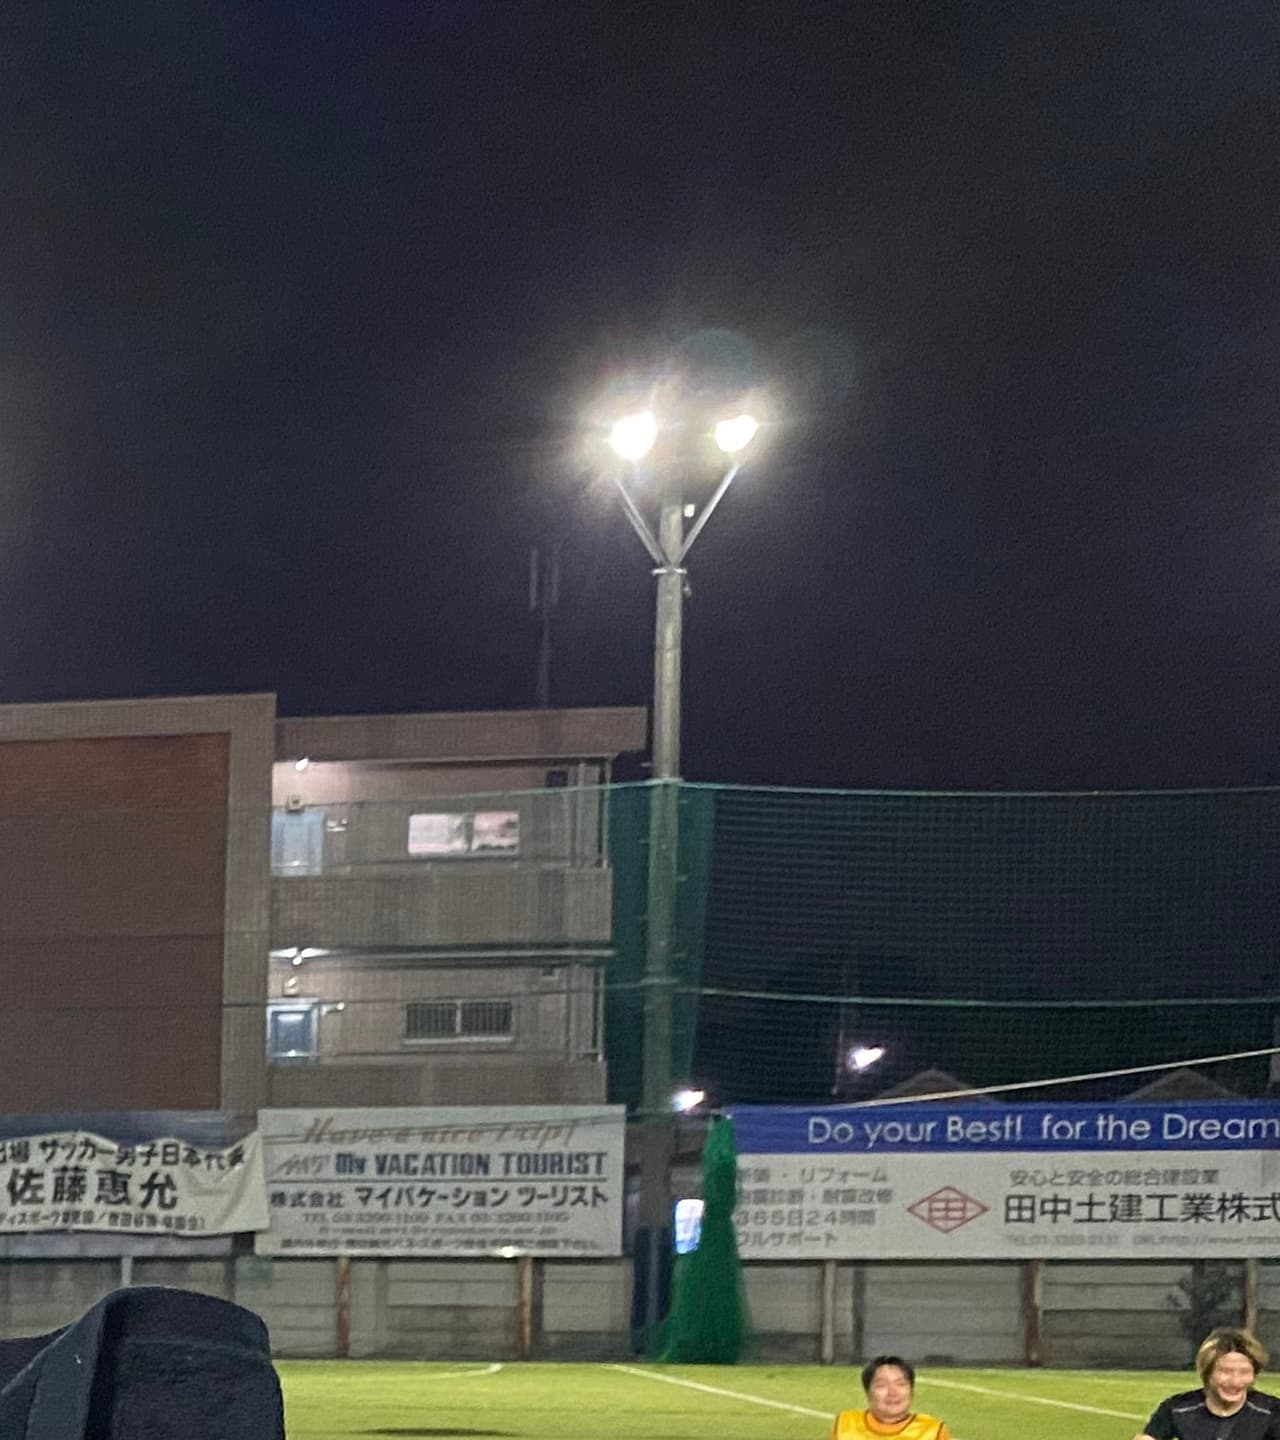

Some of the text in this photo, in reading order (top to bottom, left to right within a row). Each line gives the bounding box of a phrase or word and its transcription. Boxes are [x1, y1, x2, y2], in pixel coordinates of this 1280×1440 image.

[808, 1112, 1280, 1149] Do your Best! for the Dream
[374, 1151, 491, 1176] VACATION
[499, 1151, 608, 1176] TOURIST
[1009, 1168, 1220, 1187] 安心と安全の総合建設業
[271, 1185, 608, 1208] 株式会社 マイバケーション ツーリスト
[1004, 1192, 1280, 1224] 田中土建工業株式
